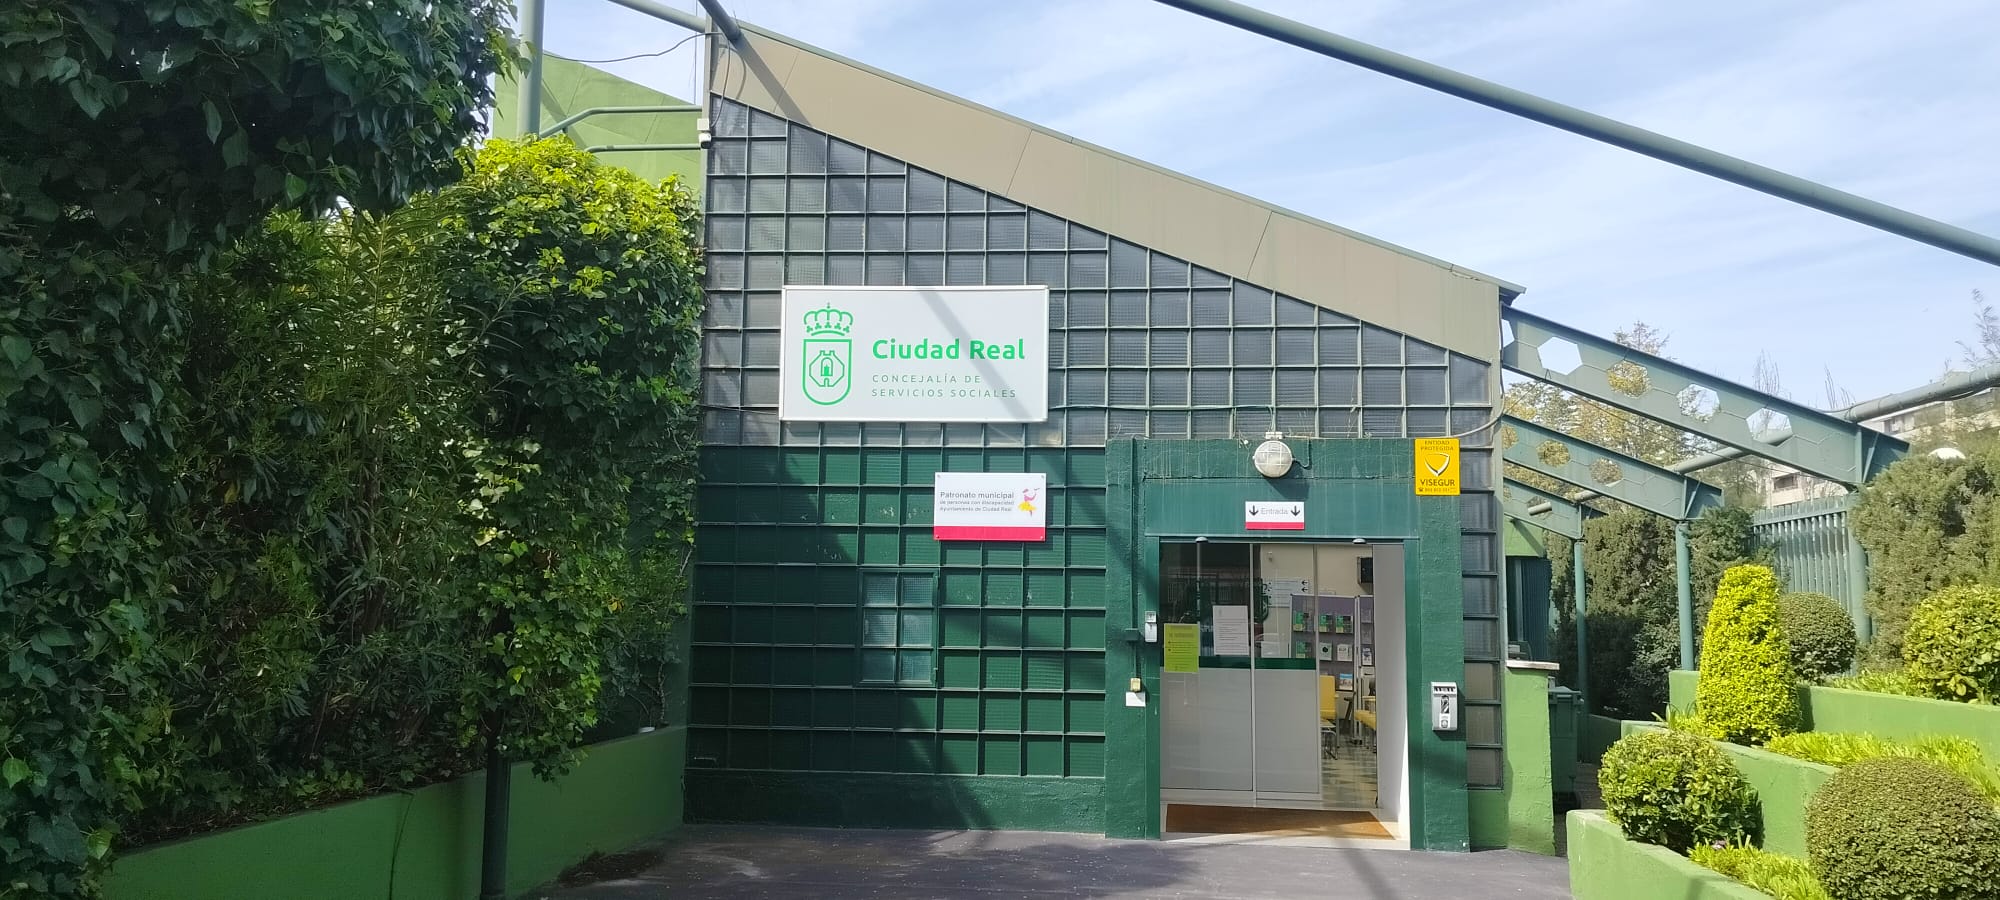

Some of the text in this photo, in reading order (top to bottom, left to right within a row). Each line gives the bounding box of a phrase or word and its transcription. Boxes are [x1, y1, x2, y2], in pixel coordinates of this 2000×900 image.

[872, 338, 1025, 360] Ciudad Real
[872, 373, 982, 384] CONCEJALÍA DE
[871, 388, 1017, 398] SERVICIOS SOCIALES
[1420, 479, 1456, 487] VISEGUR
[978, 491, 1014, 500] municipal
[1260, 507, 1289, 515] Entrada
